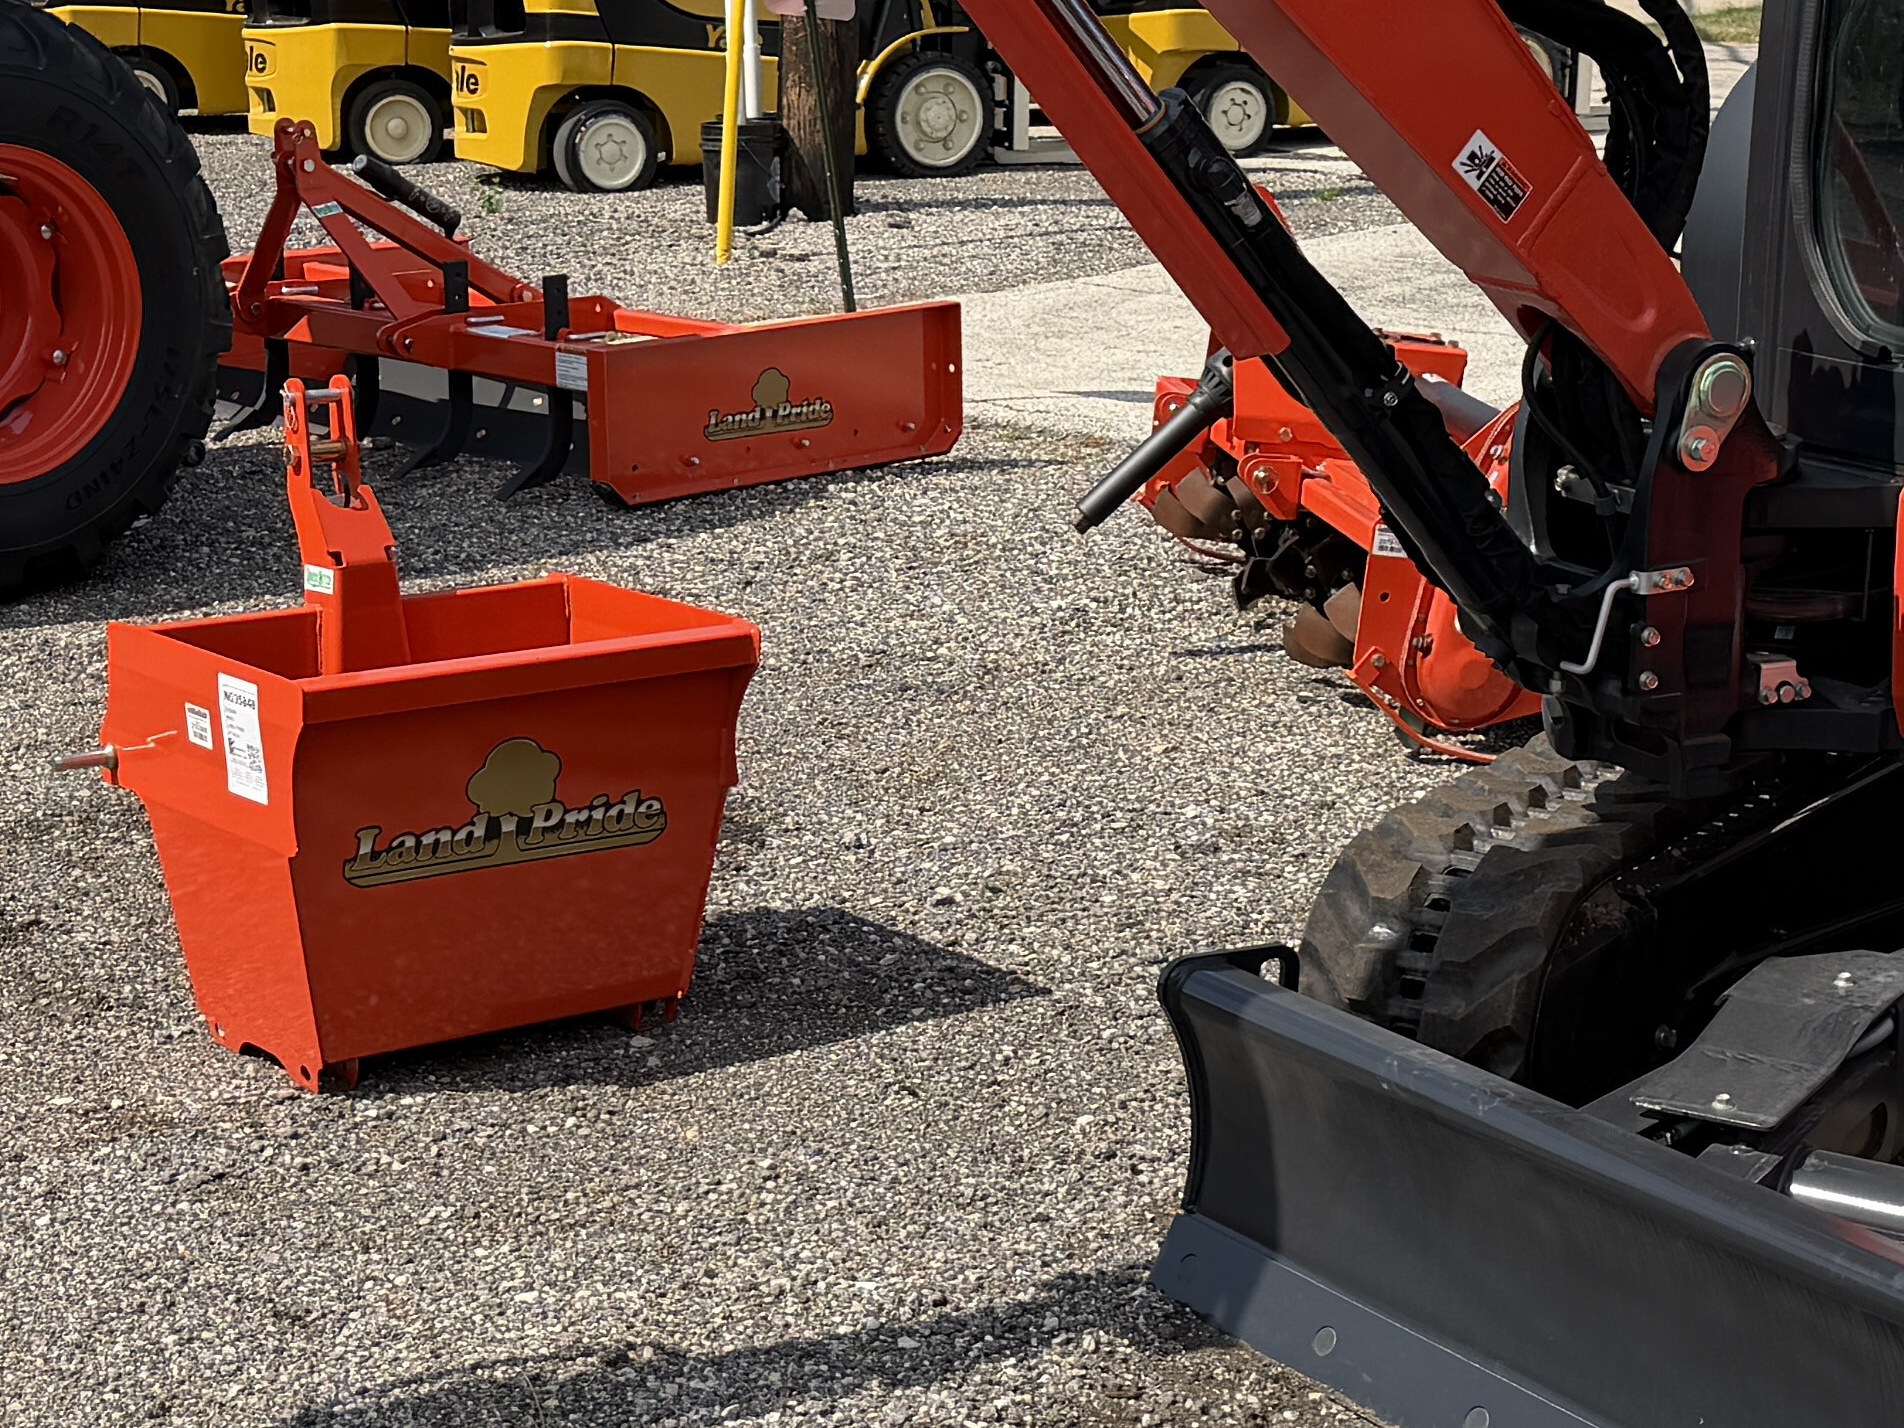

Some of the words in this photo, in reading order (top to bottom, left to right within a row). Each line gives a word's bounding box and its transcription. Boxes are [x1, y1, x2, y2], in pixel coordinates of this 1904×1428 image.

[245, 45, 267, 74] le
[455, 62, 480, 96] le
[708, 406, 762, 435] Land
[775, 397, 832, 425] Pride
[352, 813, 486, 872] Land
[526, 790, 666, 848] Pride
